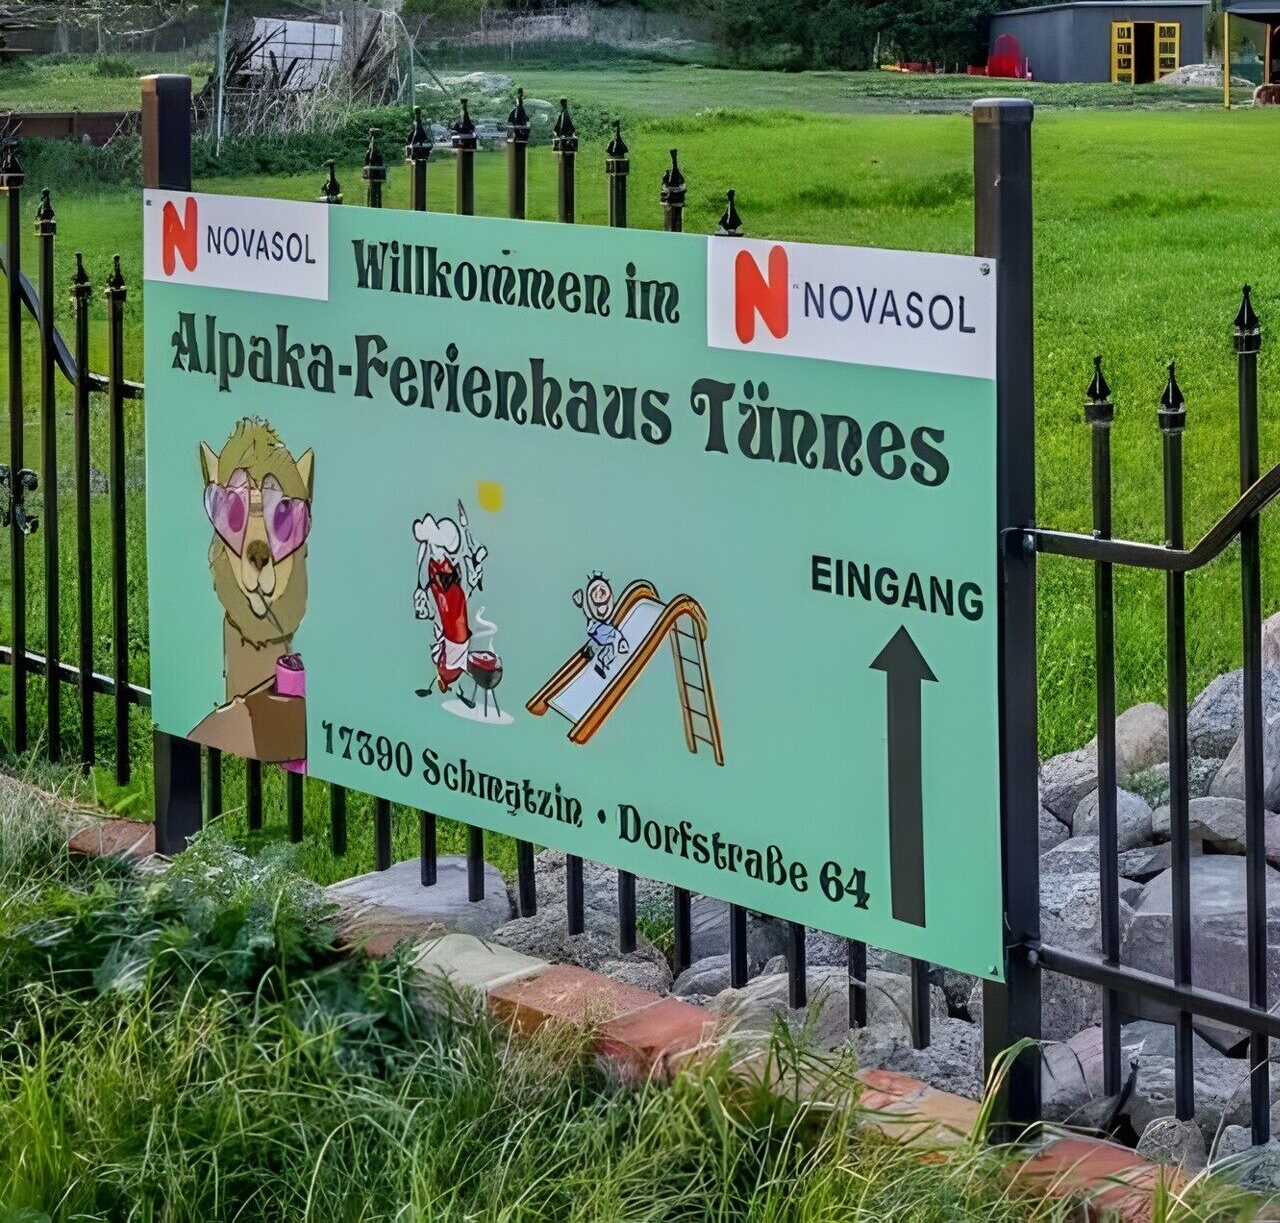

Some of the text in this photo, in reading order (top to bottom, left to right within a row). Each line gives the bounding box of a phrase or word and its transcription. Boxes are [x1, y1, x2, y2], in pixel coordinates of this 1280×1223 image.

[207, 225, 316, 265] NOVASOL
[351, 239, 680, 324] Willkommen im
[804, 281, 976, 334] NOVASOL
[171, 310, 950, 487] Alpaka-Ferienhaus Tünnes
[811, 554, 984, 622] EINGANG
[321, 719, 413, 778] 17390
[617, 803, 808, 893] Dorfstraße
[819, 860, 871, 911] 64
